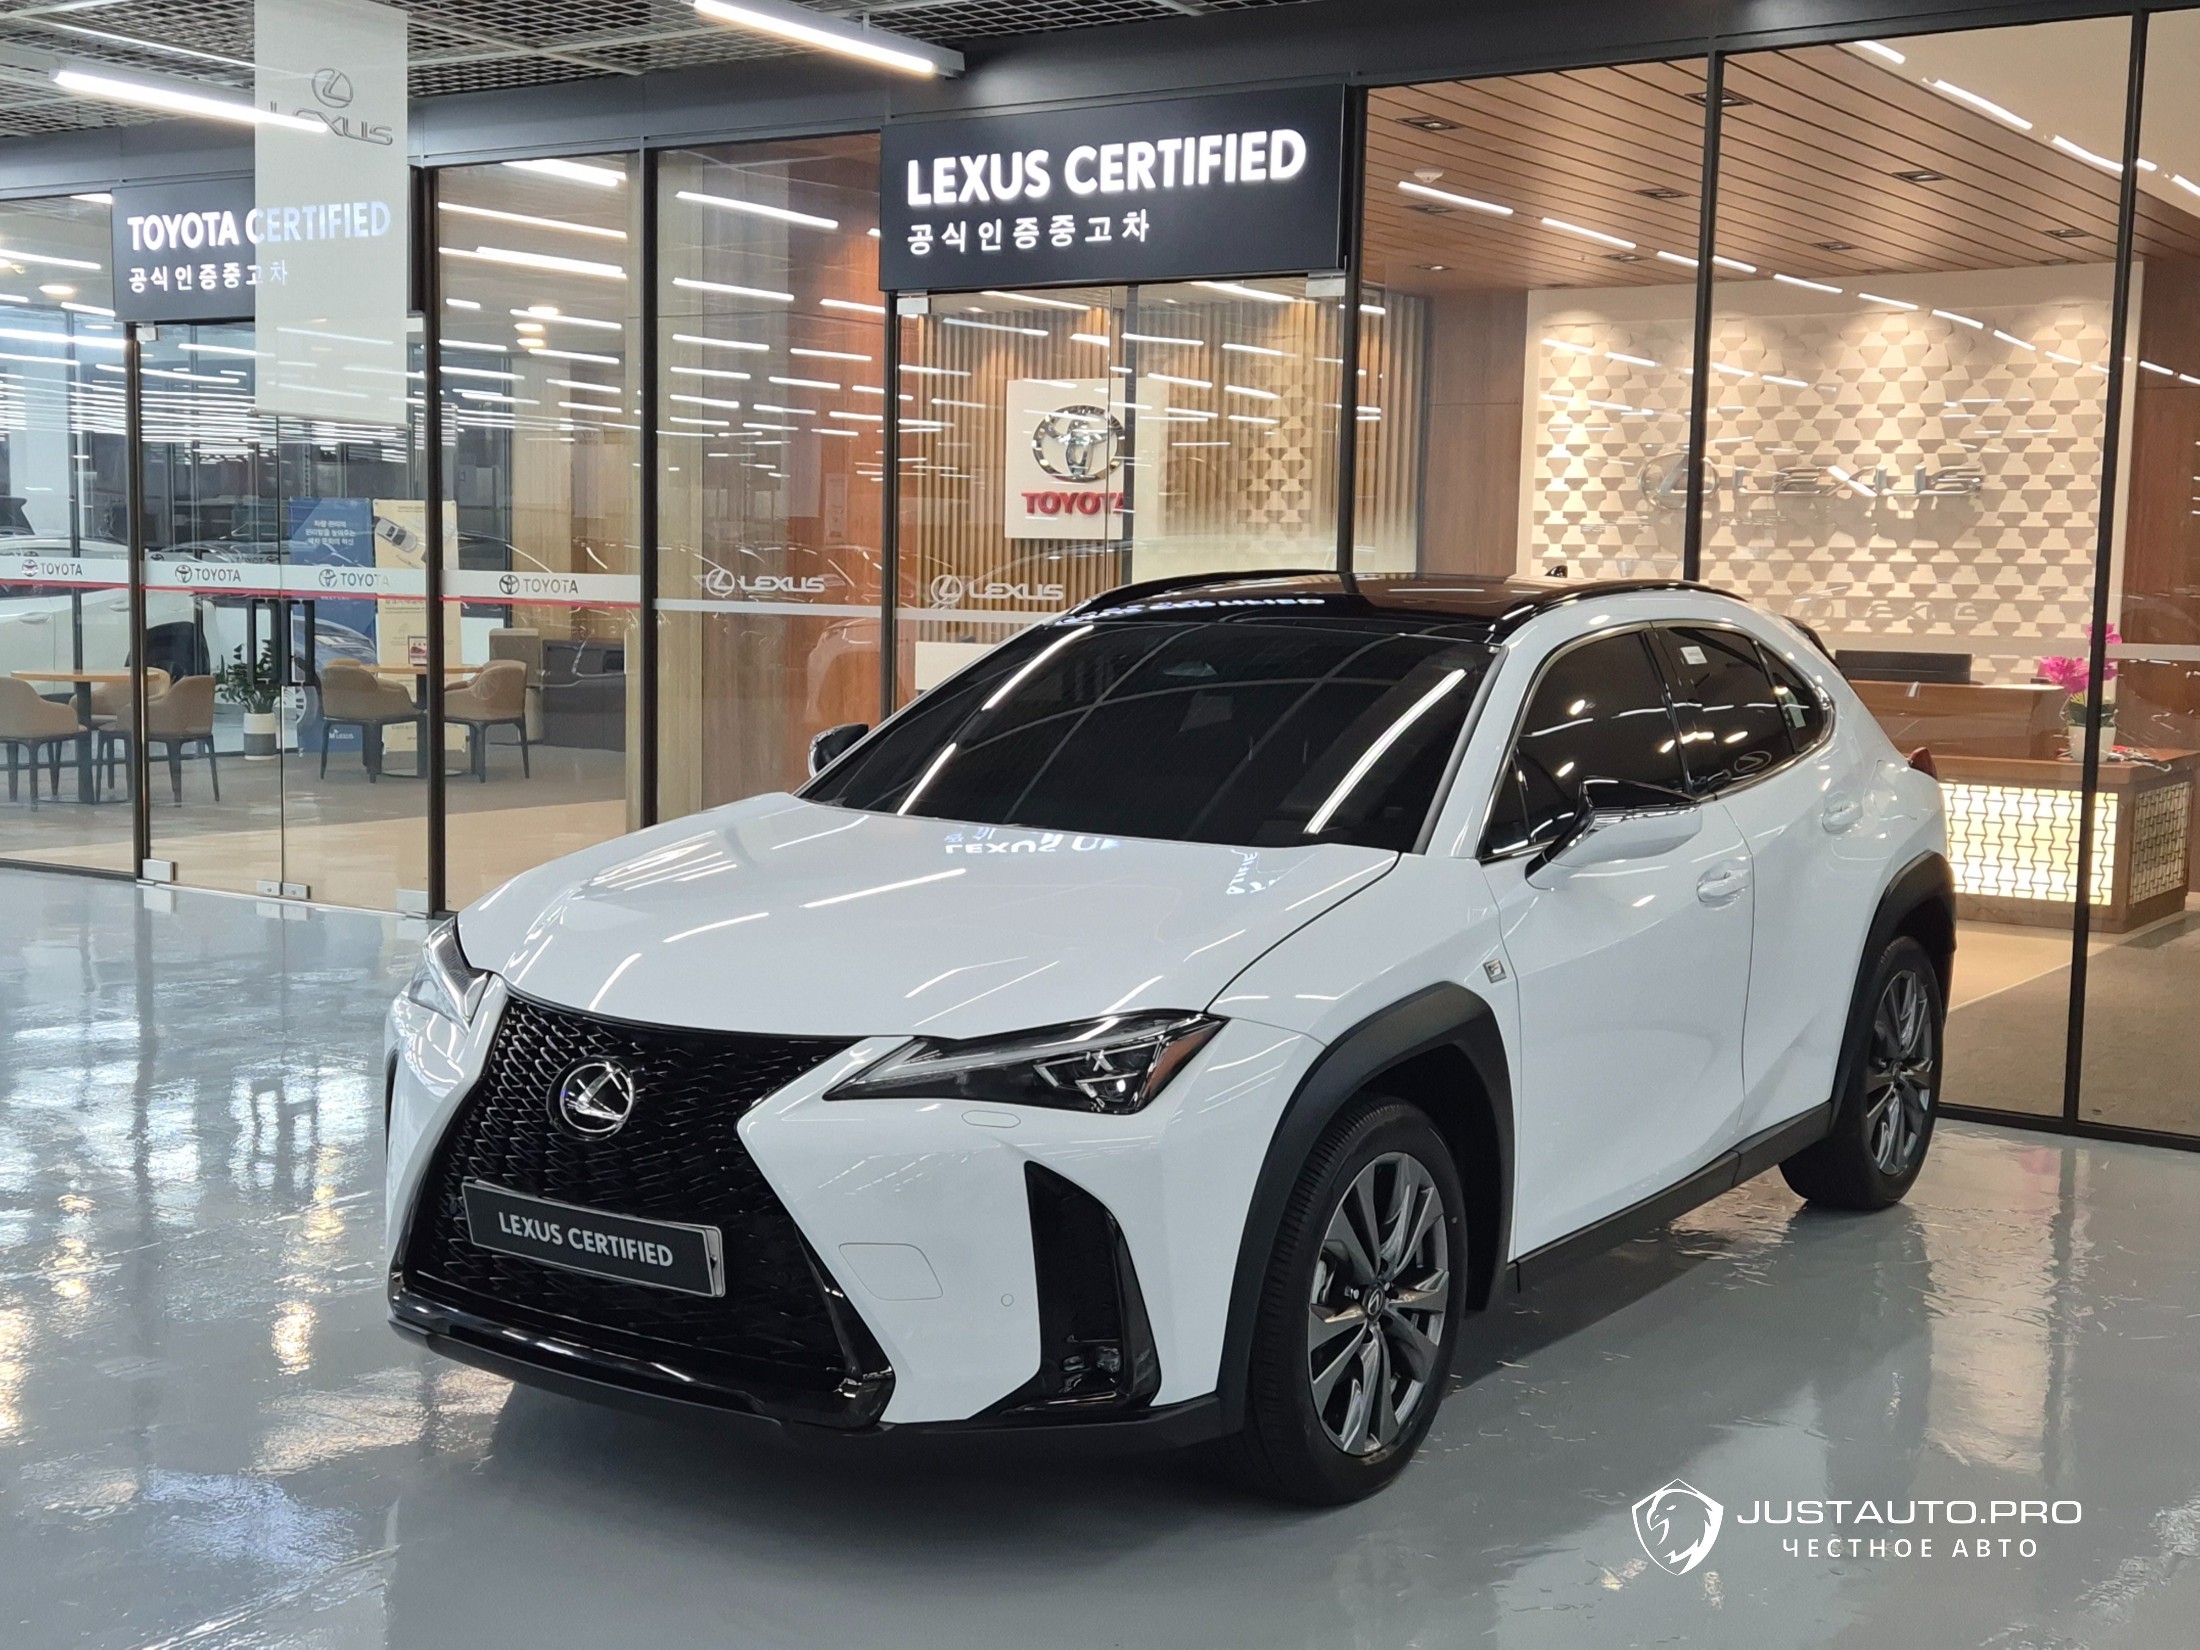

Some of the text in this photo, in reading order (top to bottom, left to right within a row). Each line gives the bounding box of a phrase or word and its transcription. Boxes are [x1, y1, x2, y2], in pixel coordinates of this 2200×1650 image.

[270, 100, 393, 146] XUS
[906, 127, 1308, 208] LEXUS CERTIFIED
[127, 200, 391, 251] TOYOTA CERTIFIED
[1732, 465, 1984, 498] LEXUS
[40, 563, 83, 576] TOYOTA
[195, 568, 242, 582] TOYOTA
[340, 572, 390, 587] TOYOTA
[523, 578, 579, 594] TOYOTA
[739, 575, 826, 593] LEXUS
[968, 582, 1064, 600] LEXUS
[498, 1211, 673, 1267] LEXUS CERTIFIED
